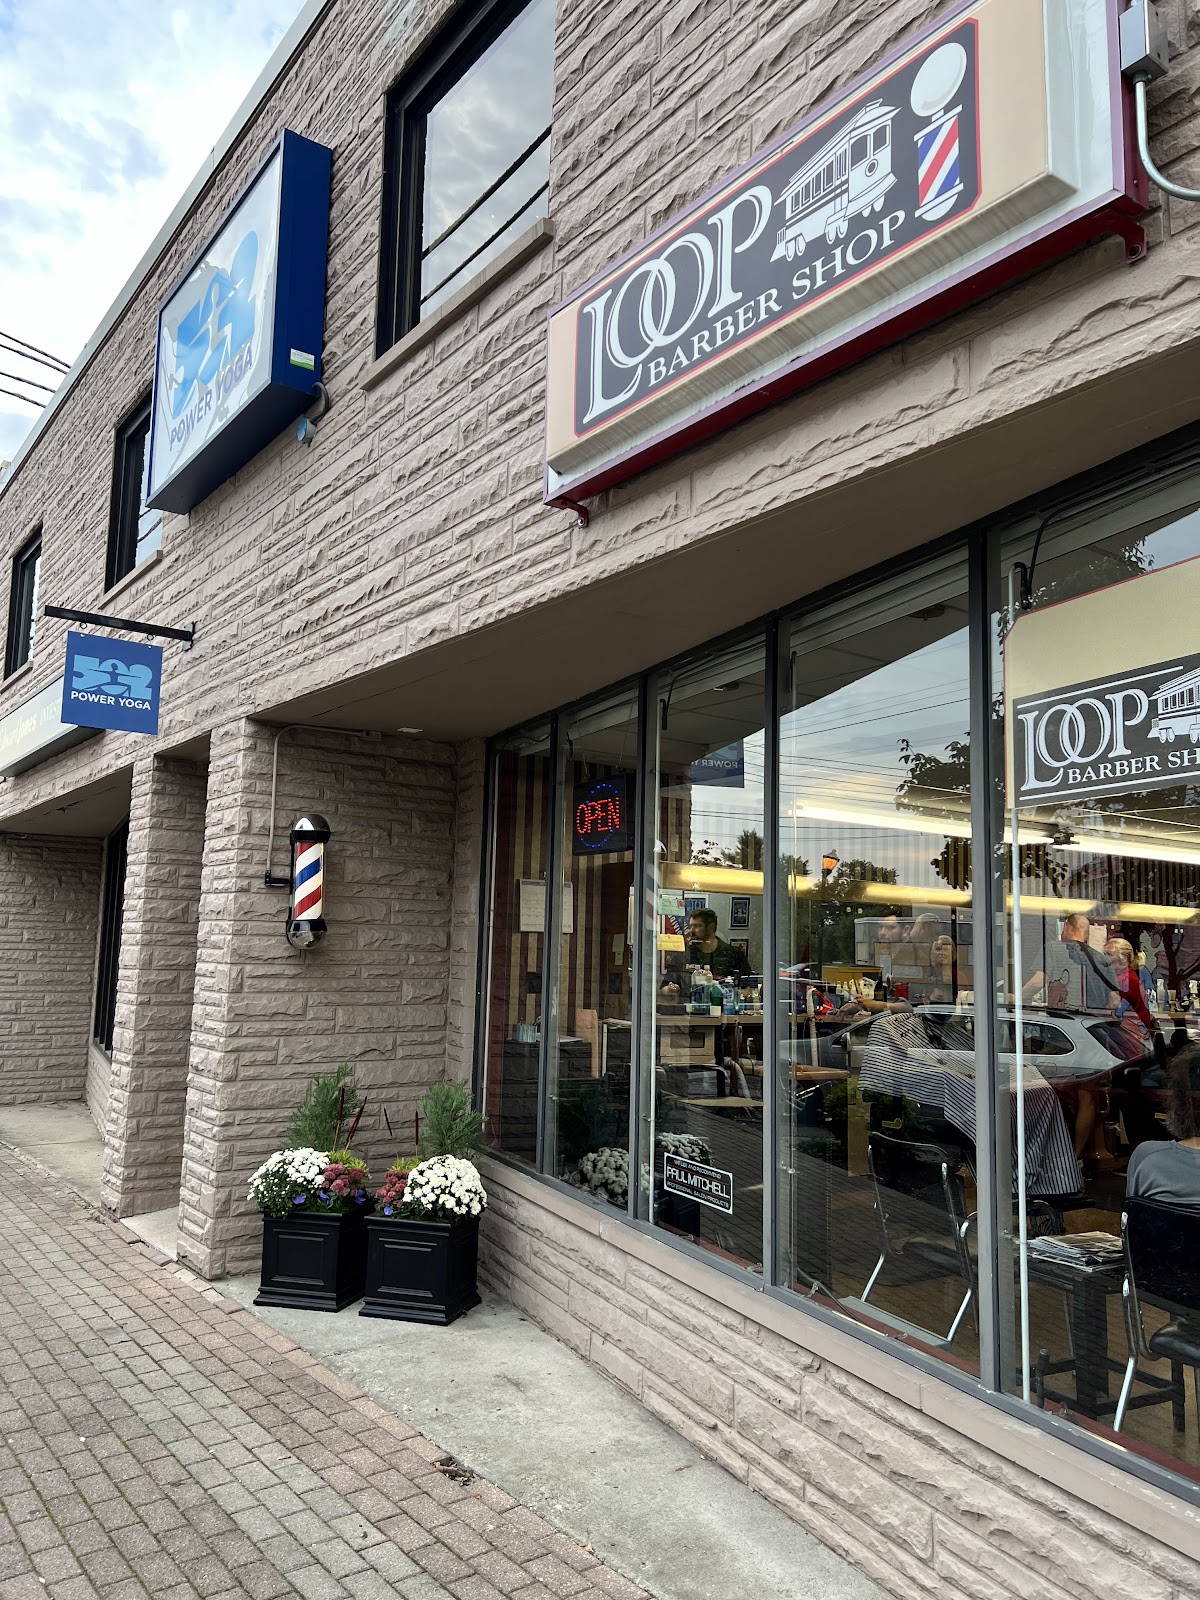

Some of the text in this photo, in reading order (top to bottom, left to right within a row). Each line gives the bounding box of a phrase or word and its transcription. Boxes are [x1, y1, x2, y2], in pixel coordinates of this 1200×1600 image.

[582, 185, 773, 425] LOOP
[647, 209, 906, 388] BARBER SHOP
[169, 344, 254, 447] POWER YOGA
[70, 690, 152, 711] POWER YOGA
[1017, 688, 1149, 791] LOOP
[1066, 755, 1162, 785] BARBER
[576, 797, 620, 834] OPEN
[666, 1165, 731, 1199] PAUL MITCHELL
